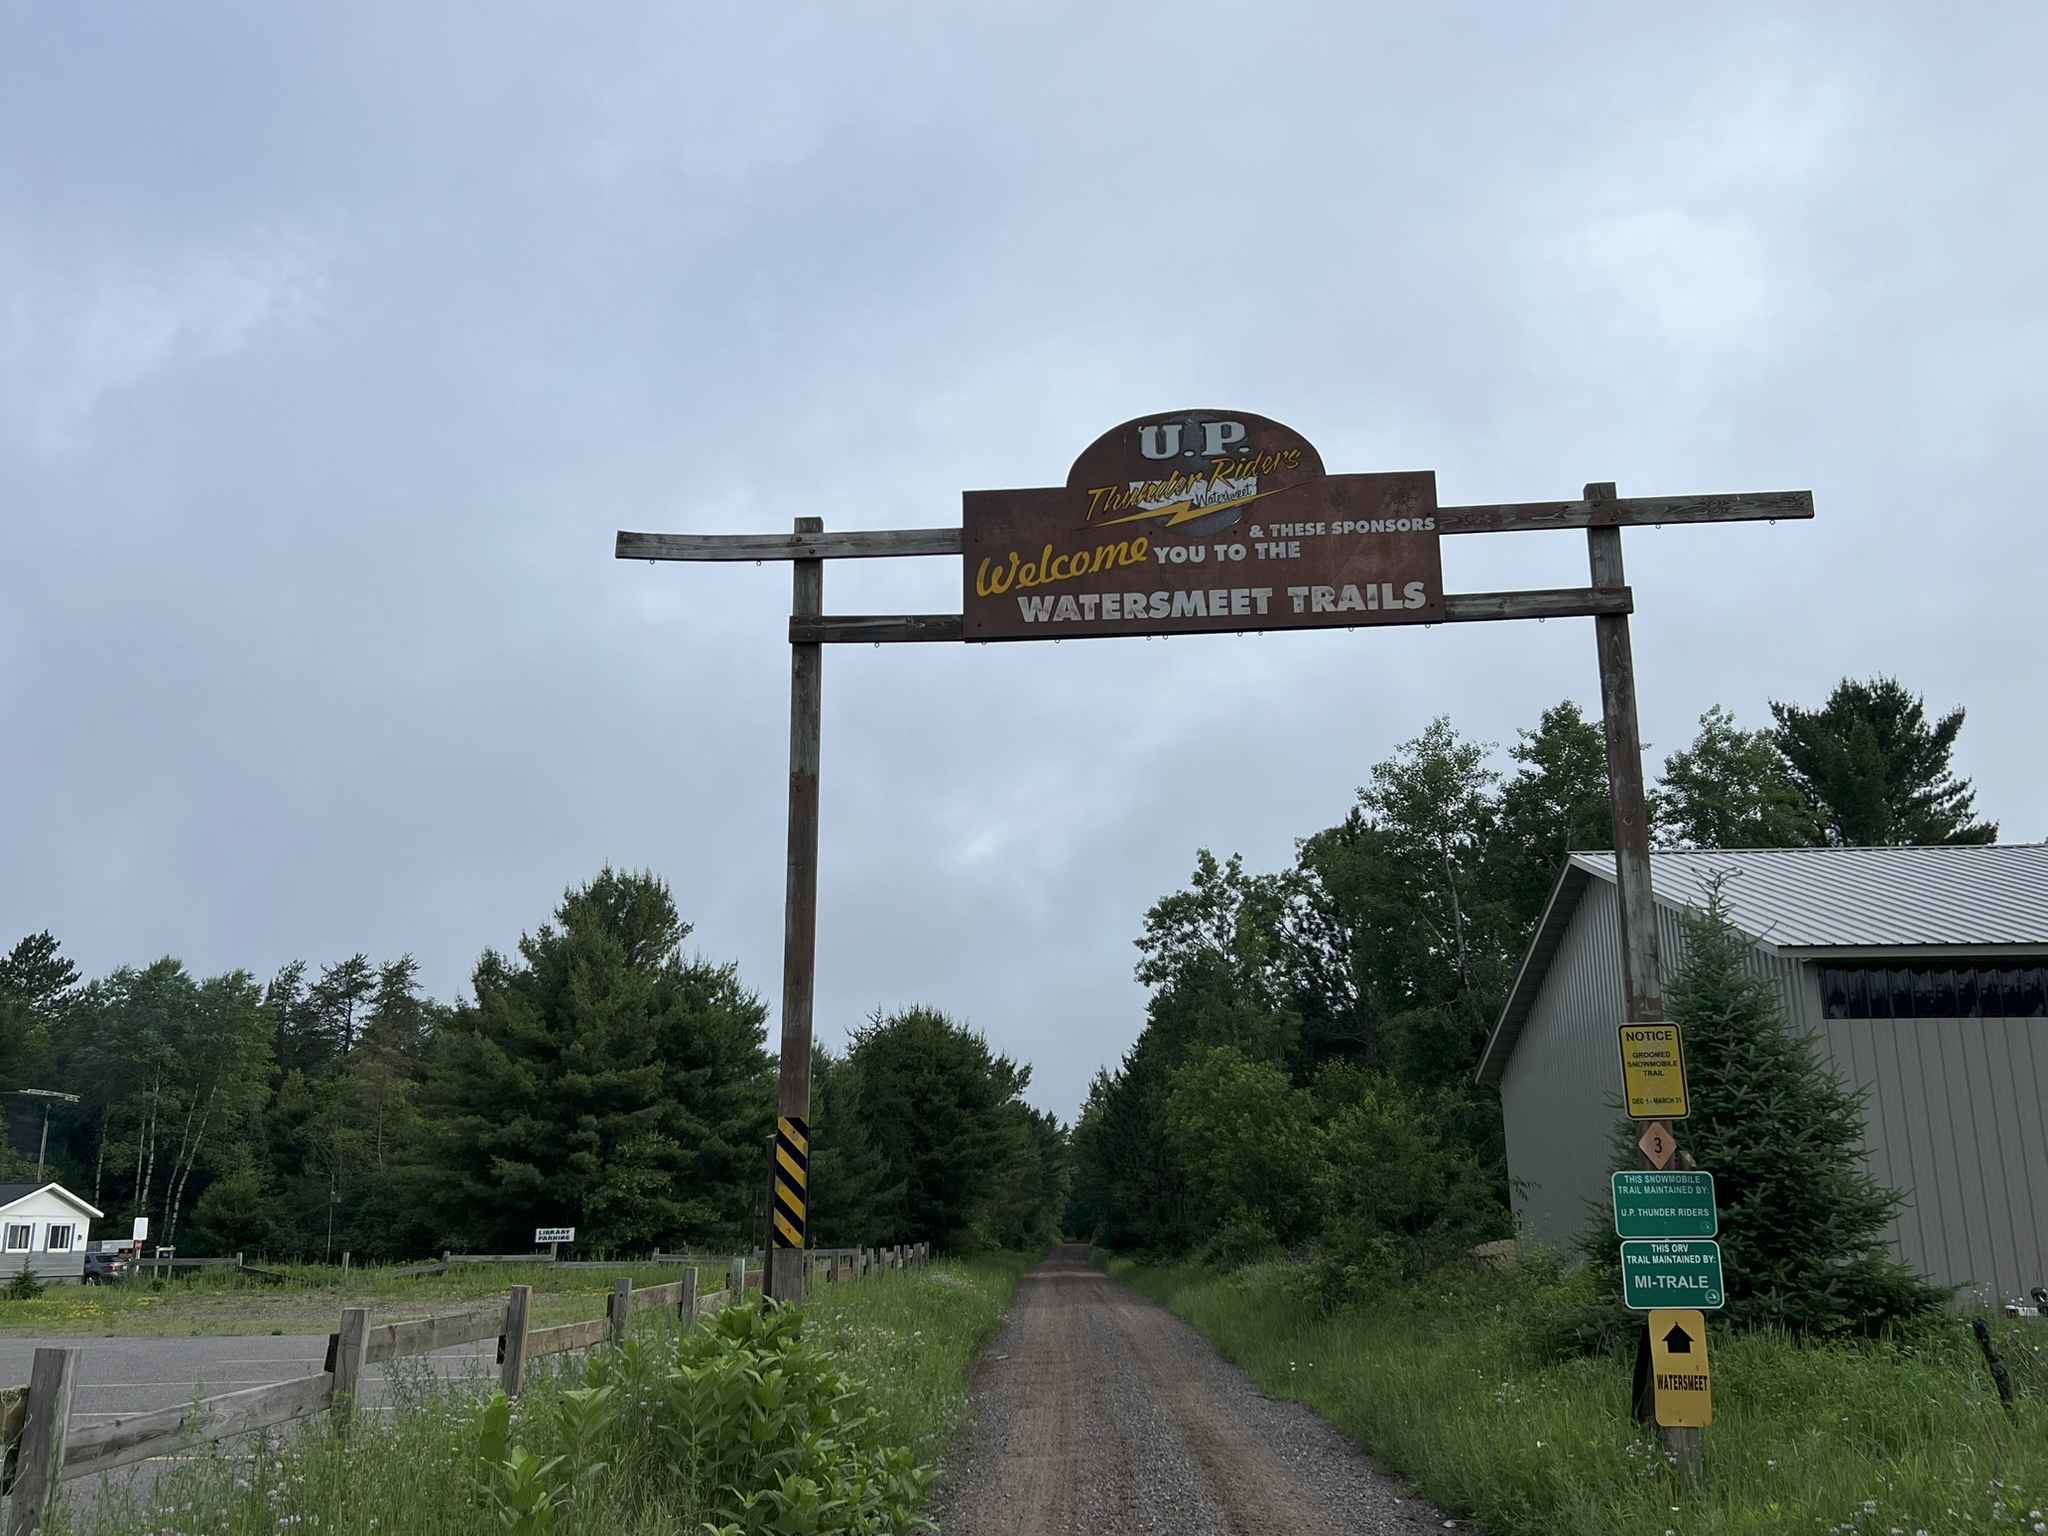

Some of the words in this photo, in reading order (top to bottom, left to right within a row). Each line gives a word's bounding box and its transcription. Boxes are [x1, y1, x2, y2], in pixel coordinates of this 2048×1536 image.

[1138, 421, 1250, 460] U.P.
[1085, 469, 1203, 521] Thunder
[1206, 448, 1301, 490] Riders
[1249, 525, 1263, 538] &
[1269, 522, 1327, 537] THESE
[1331, 517, 1436, 535] SPONSORS
[976, 536, 1149, 598] Welcome
[1154, 544, 1206, 565] YOU
[1214, 544, 1248, 562] TO
[1255, 541, 1301, 561] THE
[1017, 587, 1273, 623] WATERSMEET
[1287, 581, 1427, 613] TRAILS
[1626, 1031, 1673, 1041] NOTICE
[1627, 1060, 1678, 1068] SNOWMOBILE
[1654, 1136, 1663, 1154] 3
[1624, 1175, 1643, 1184] THIS
[1645, 1175, 1701, 1184] SNOWMOBILE
[1618, 1186, 1642, 1194] TRAIL
[1644, 1185, 1694, 1194] MAINTAINED
[1638, 1208, 1676, 1217] THUNDER
[1678, 1208, 1710, 1217] RIDERS
[1651, 1244, 1670, 1253] THIS
[1671, 1244, 1688, 1253] ORV
[1627, 1255, 1650, 1264] TRAIL
[1652, 1255, 1701, 1264] MAINTAINED
[1703, 1255, 1717, 1264] BY:
[1635, 1275, 1709, 1289] MI-TRALE
[1656, 1373, 1708, 1392] WATERSMEET
